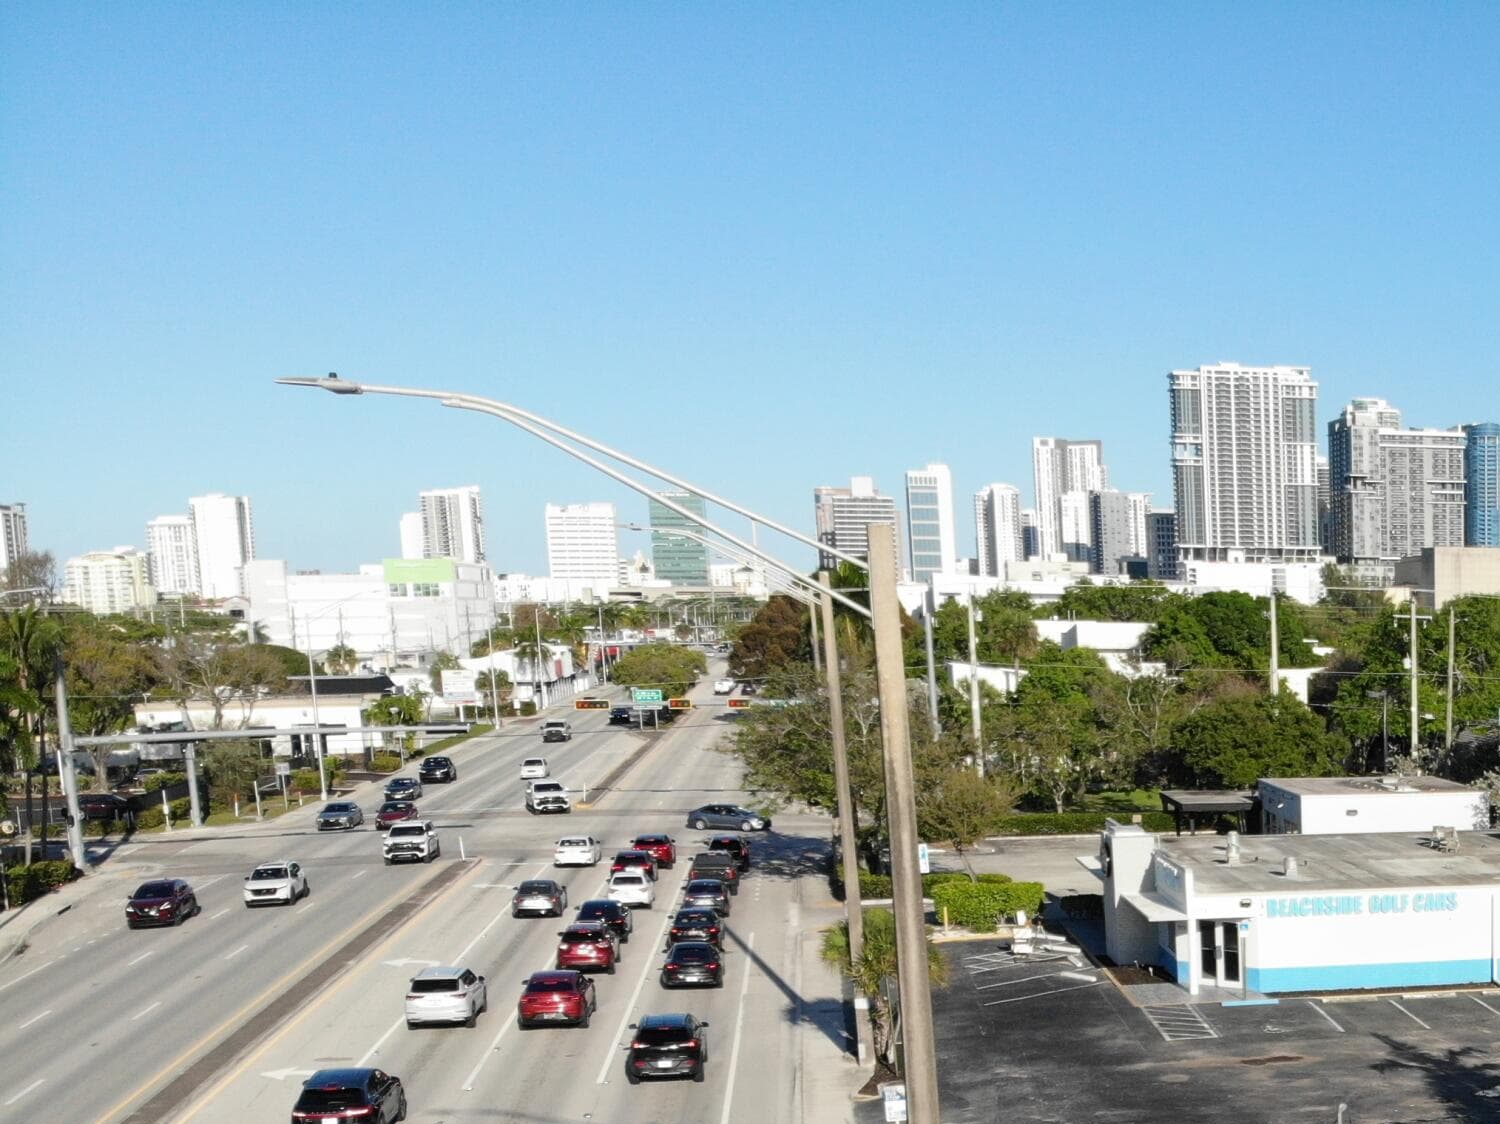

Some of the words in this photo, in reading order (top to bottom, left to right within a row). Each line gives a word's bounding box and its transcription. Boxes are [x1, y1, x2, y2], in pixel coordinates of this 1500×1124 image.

[1266, 895, 1363, 918] BEACHSIDE
[1368, 893, 1409, 914] GOLF
[1412, 892, 1459, 912] CARS
